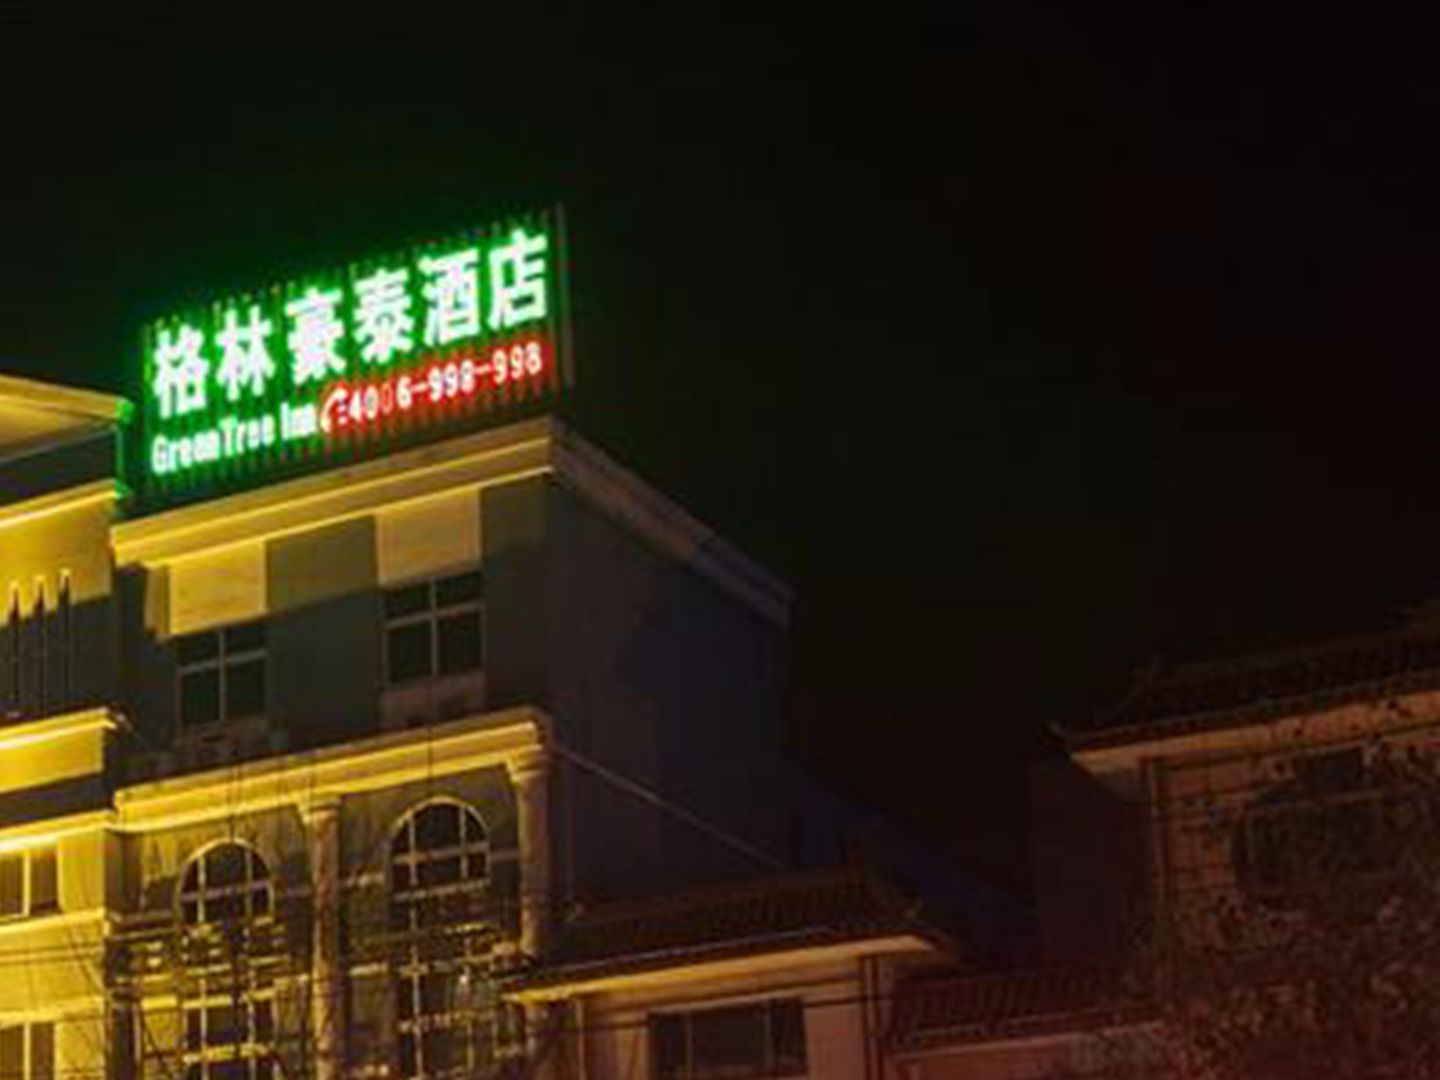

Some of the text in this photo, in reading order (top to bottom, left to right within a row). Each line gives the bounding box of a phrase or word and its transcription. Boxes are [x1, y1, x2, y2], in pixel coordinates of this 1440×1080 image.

[152, 228, 549, 419] 格林豪泰酒店
[151, 402, 317, 475] GreenTree Inn
